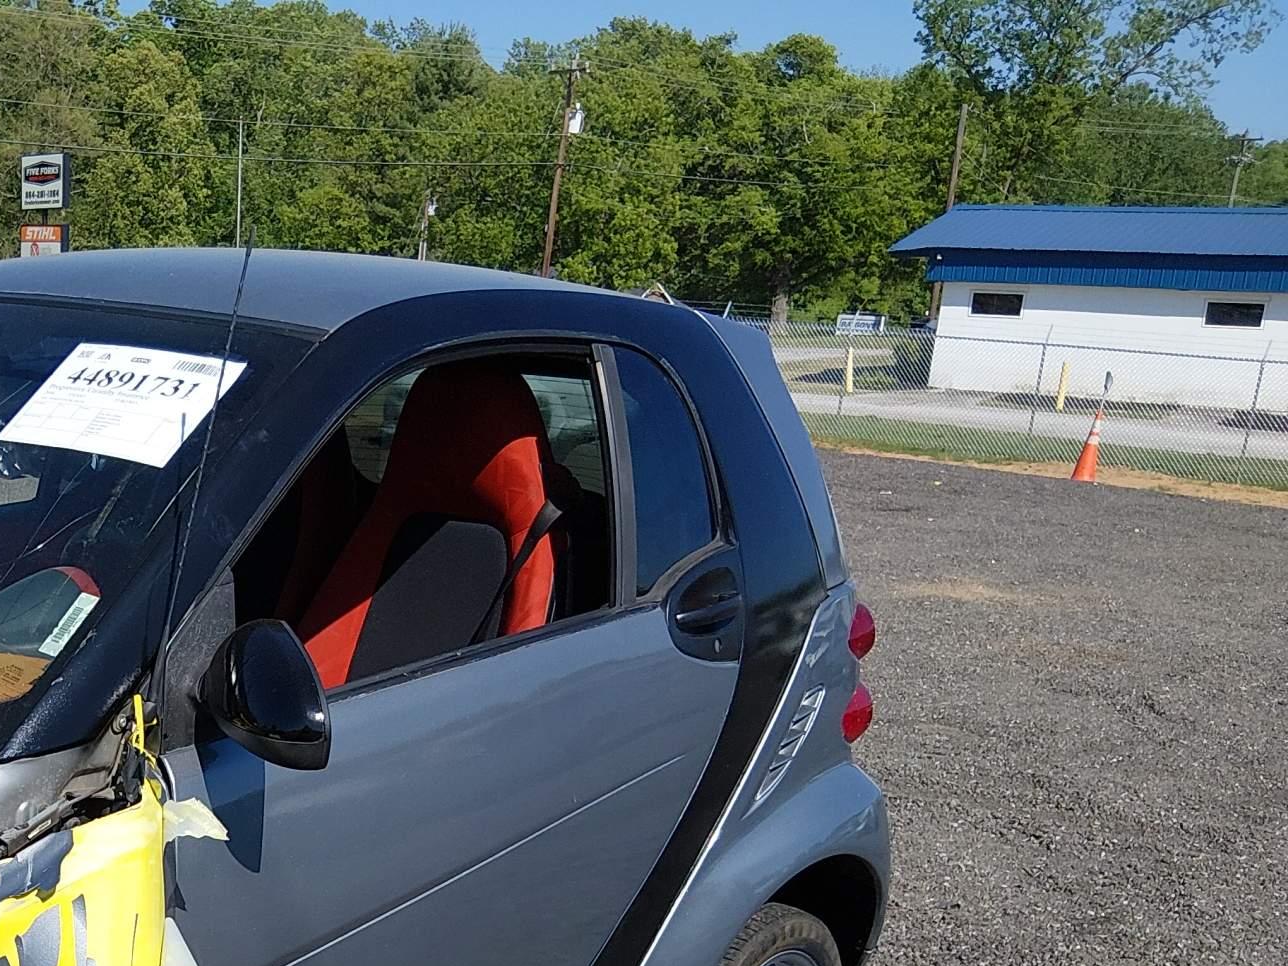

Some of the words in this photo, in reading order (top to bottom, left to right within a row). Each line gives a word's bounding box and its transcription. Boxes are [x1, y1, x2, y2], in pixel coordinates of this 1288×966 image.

[26, 167, 40, 177] FIVE
[40, 166, 59, 176] FORKS
[25, 226, 57, 240] STIHL
[67, 366, 202, 400] 44891731
